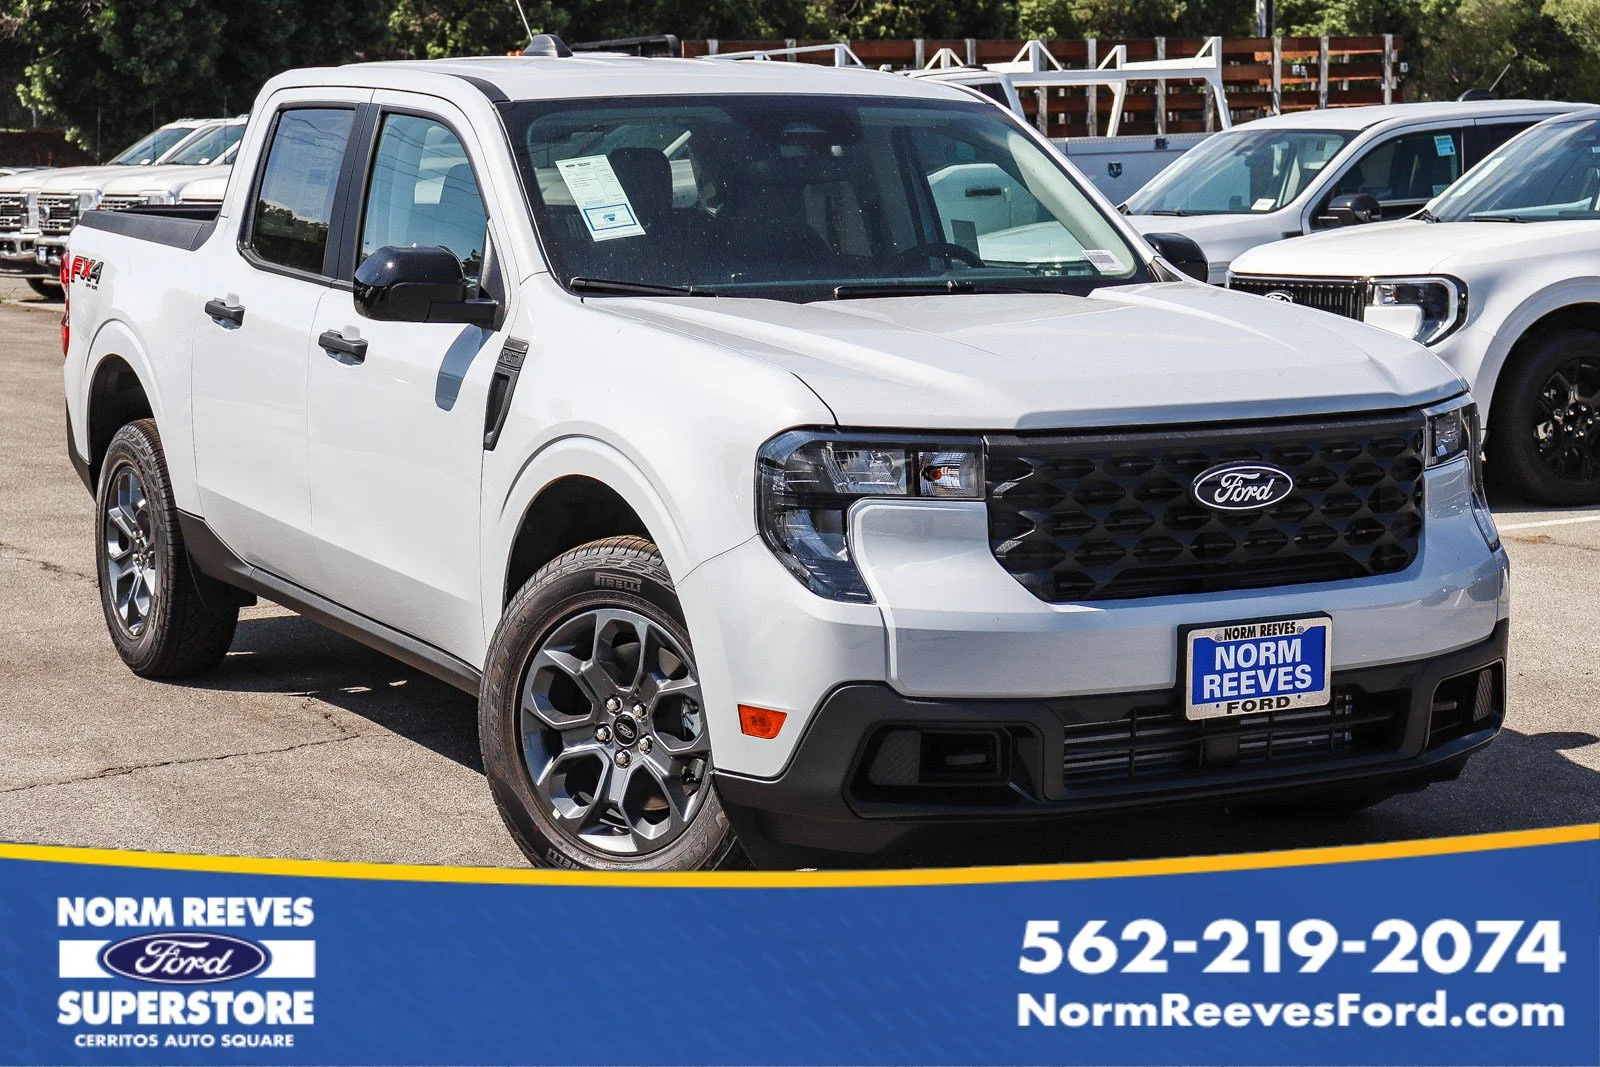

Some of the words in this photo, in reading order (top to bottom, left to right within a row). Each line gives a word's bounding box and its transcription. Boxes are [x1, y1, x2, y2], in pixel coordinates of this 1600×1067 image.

[71, 255, 104, 284] FX4
[1214, 473, 1275, 503] Ford
[595, 572, 641, 592] PIRELLI
[1224, 626, 1256, 641] NORM
[1260, 621, 1296, 636] REEVES
[1215, 638, 1302, 671] NORM
[1203, 664, 1312, 699] REEVES
[1226, 696, 1291, 714] FORD
